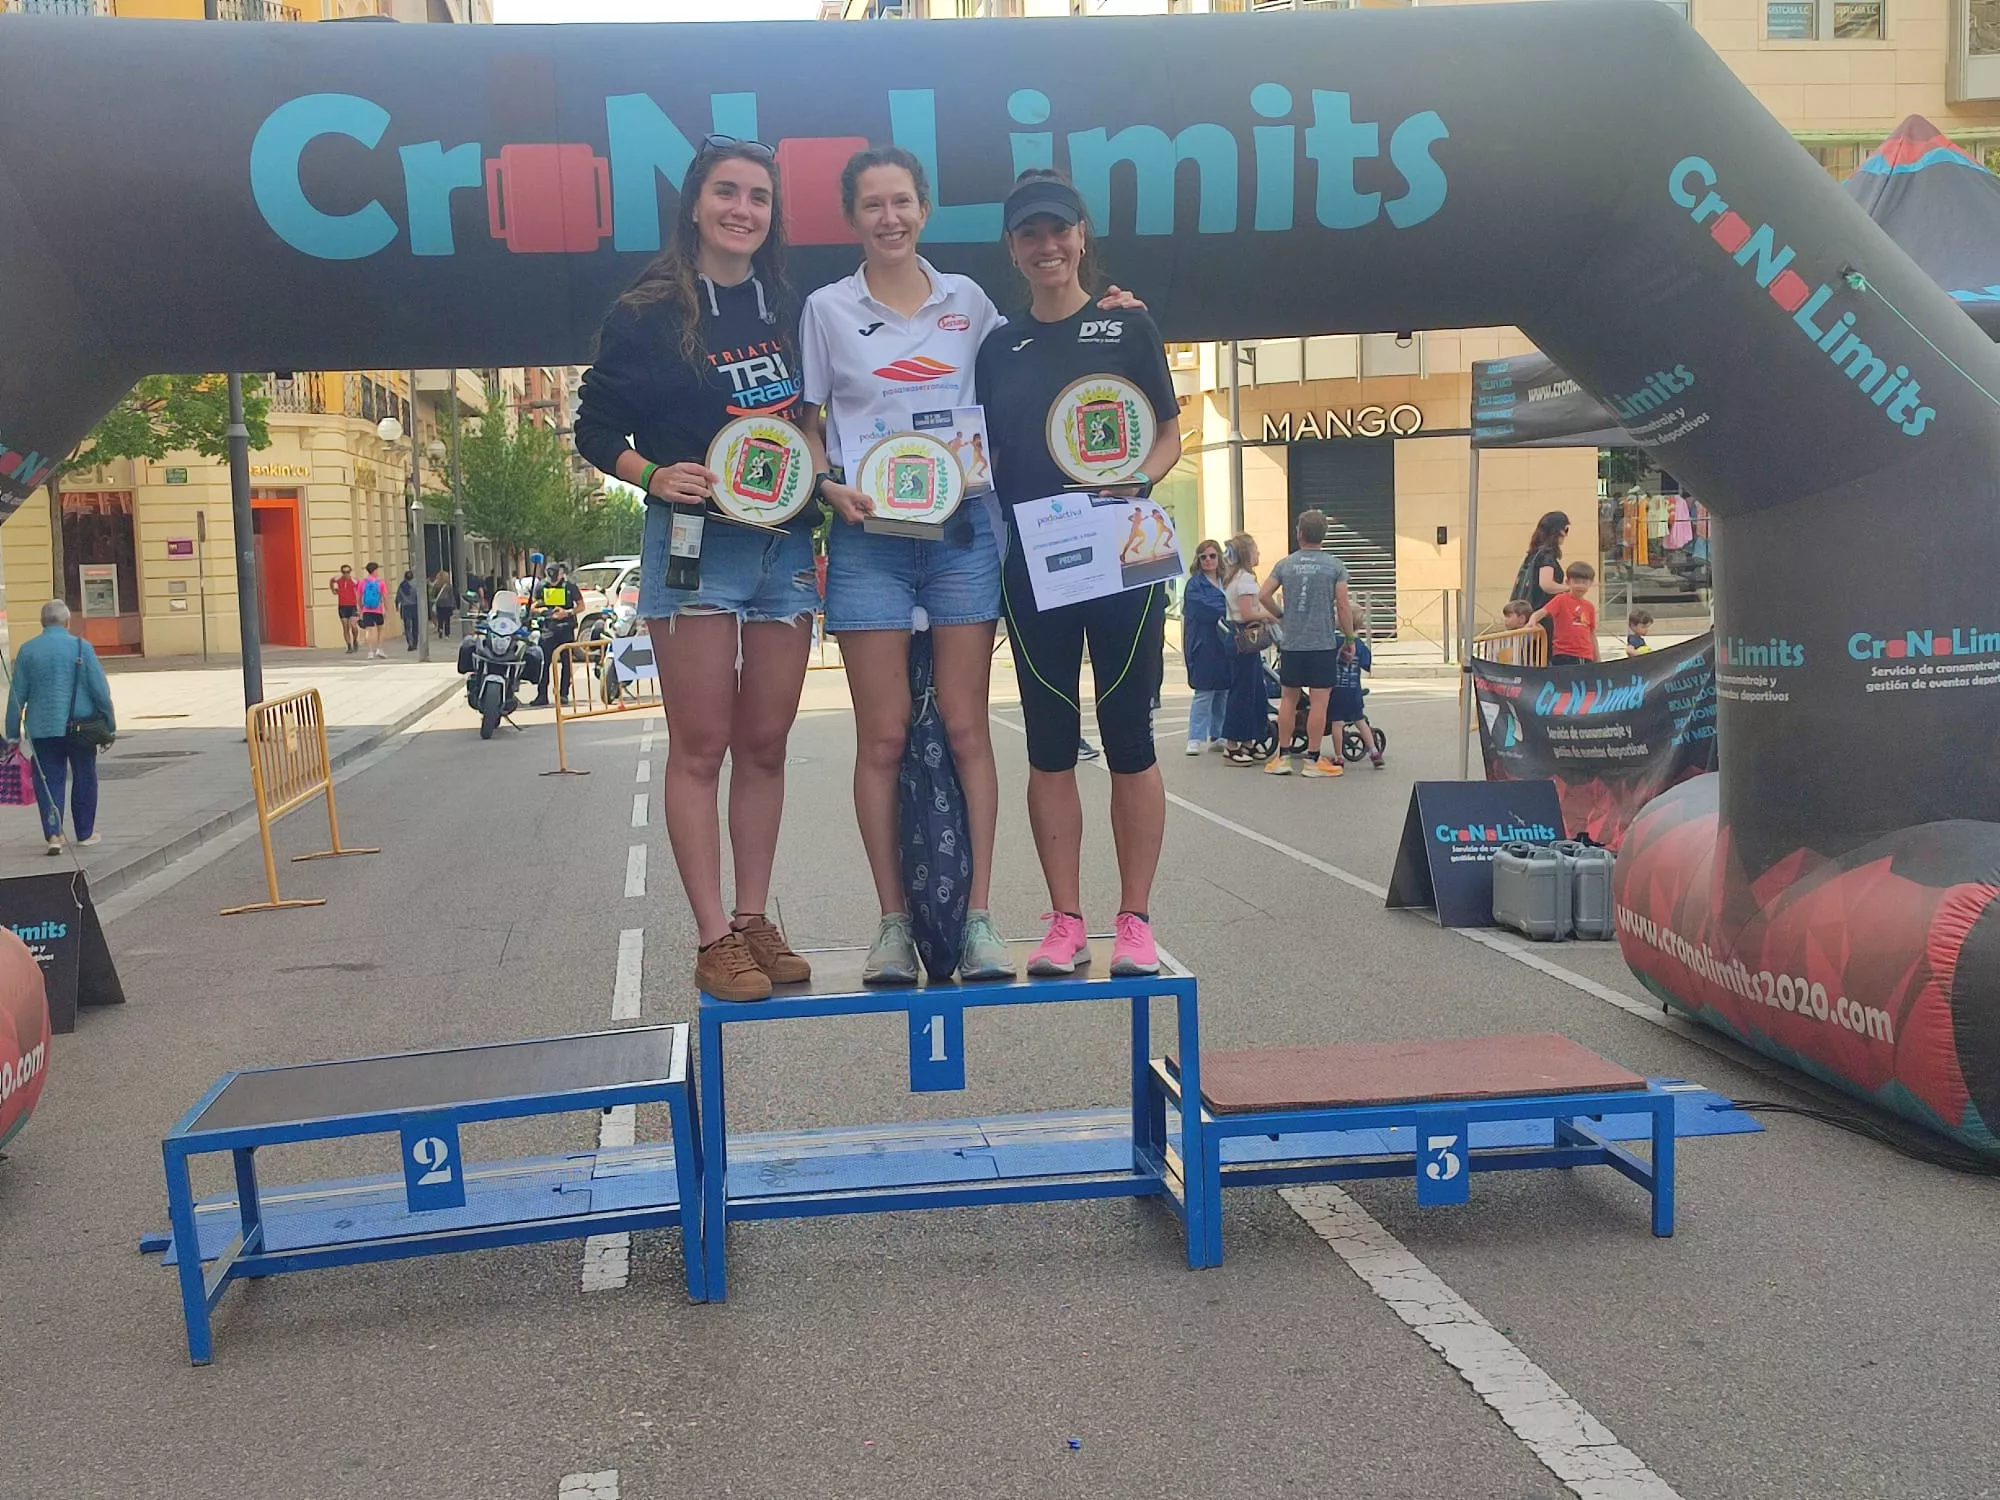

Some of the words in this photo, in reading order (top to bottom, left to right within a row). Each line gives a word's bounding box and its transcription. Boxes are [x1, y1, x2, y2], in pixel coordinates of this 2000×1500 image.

[1078, 319, 1124, 337] DYS
[706, 340, 783, 366] TRIATL
[717, 353, 790, 391] TRI
[1262, 403, 1423, 443] MANGO
[1871, 665, 1917, 677] Servicio
[1919, 663, 1934, 675] de
[1770, 677, 1777, 688] y
[1866, 680, 1909, 693] gestión
[1911, 677, 1927, 690] de
[1929, 675, 1970, 688] eventos
[1740, 690, 1790, 702] deportivos
[1691, 725, 1717, 740] MED
[1479, 845, 1488, 853] de
[12, 920, 68, 942] imits
[1616, 903, 1895, 1046] www.cronolimits2020.com
[922, 1015, 948, 1061] 1
[0, 1041, 45, 1103] 0.com
[413, 1137, 452, 1186] 2
[1426, 1135, 1460, 1180] 3
